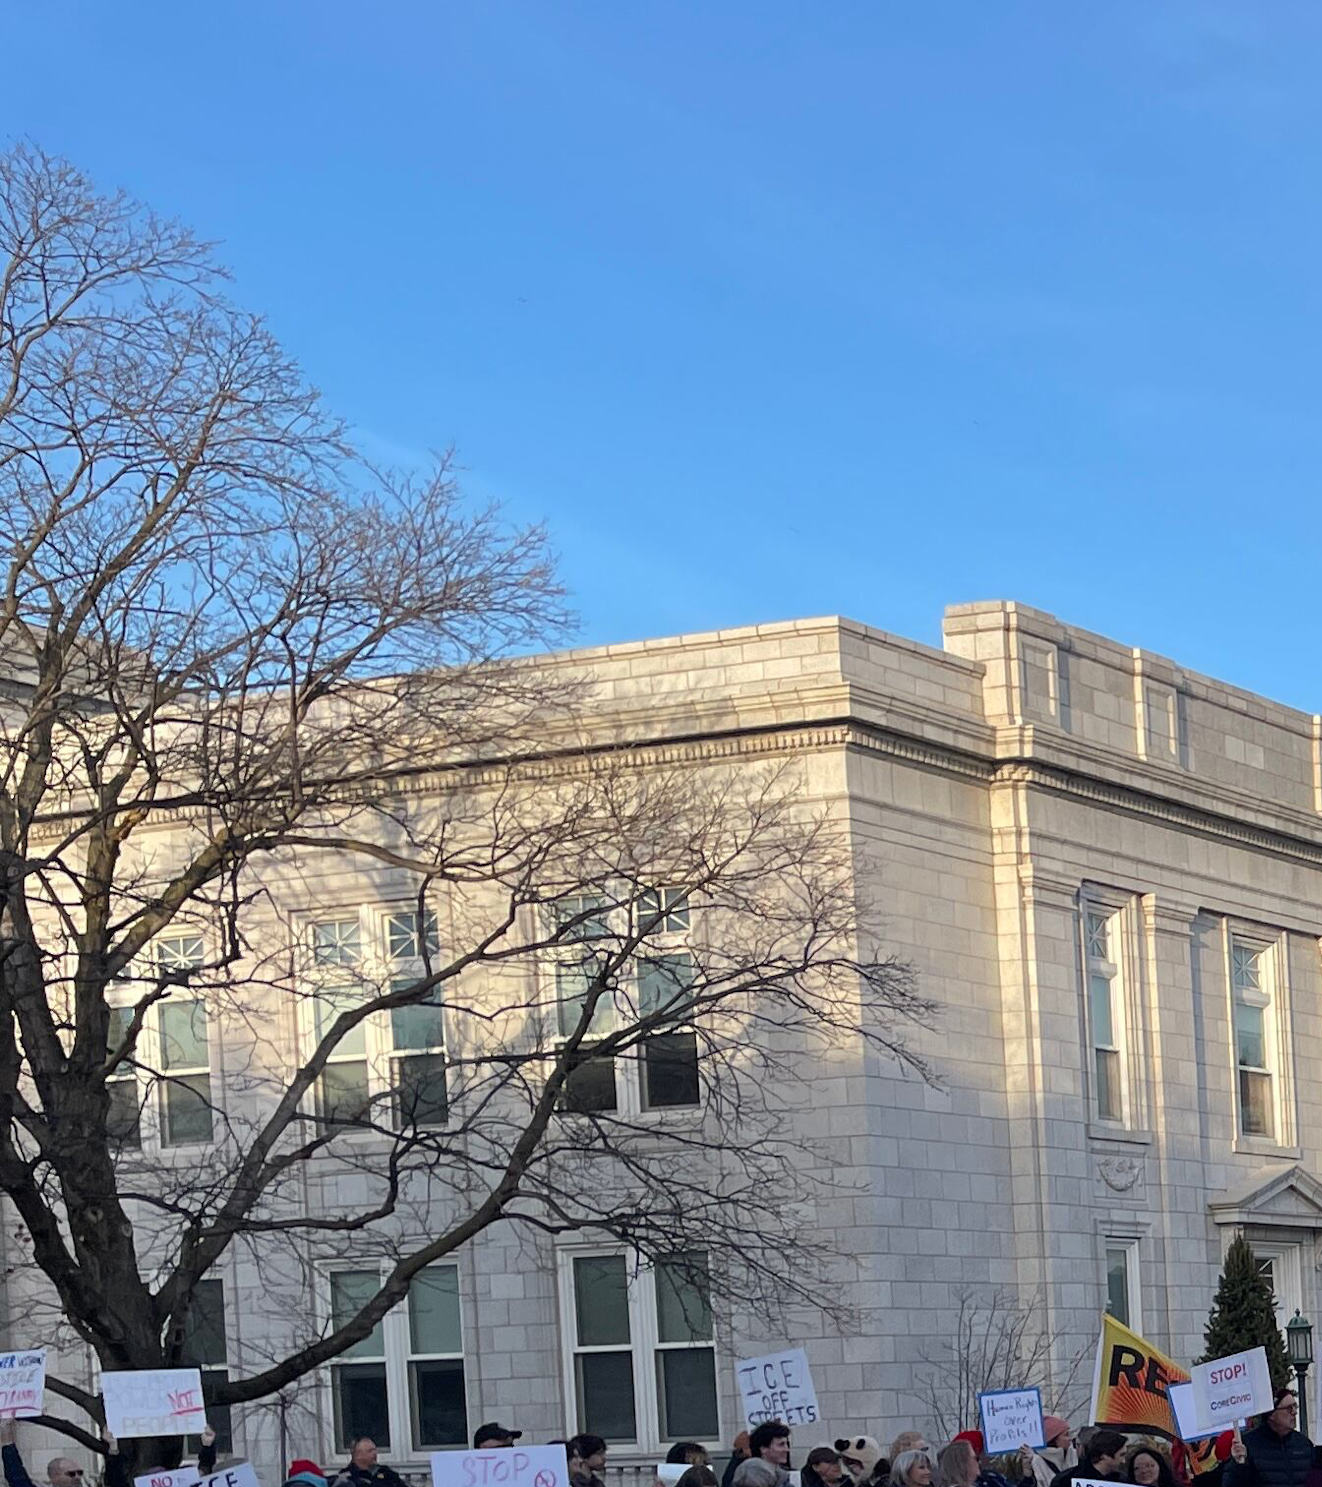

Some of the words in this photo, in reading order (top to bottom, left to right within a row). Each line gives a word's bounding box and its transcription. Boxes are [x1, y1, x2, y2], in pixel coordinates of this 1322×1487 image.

[739, 1360, 800, 1396] ICE
[1210, 1362, 1247, 1385] STOP!
[167, 1389, 199, 1408] NOT
[762, 1391, 784, 1410] OFF
